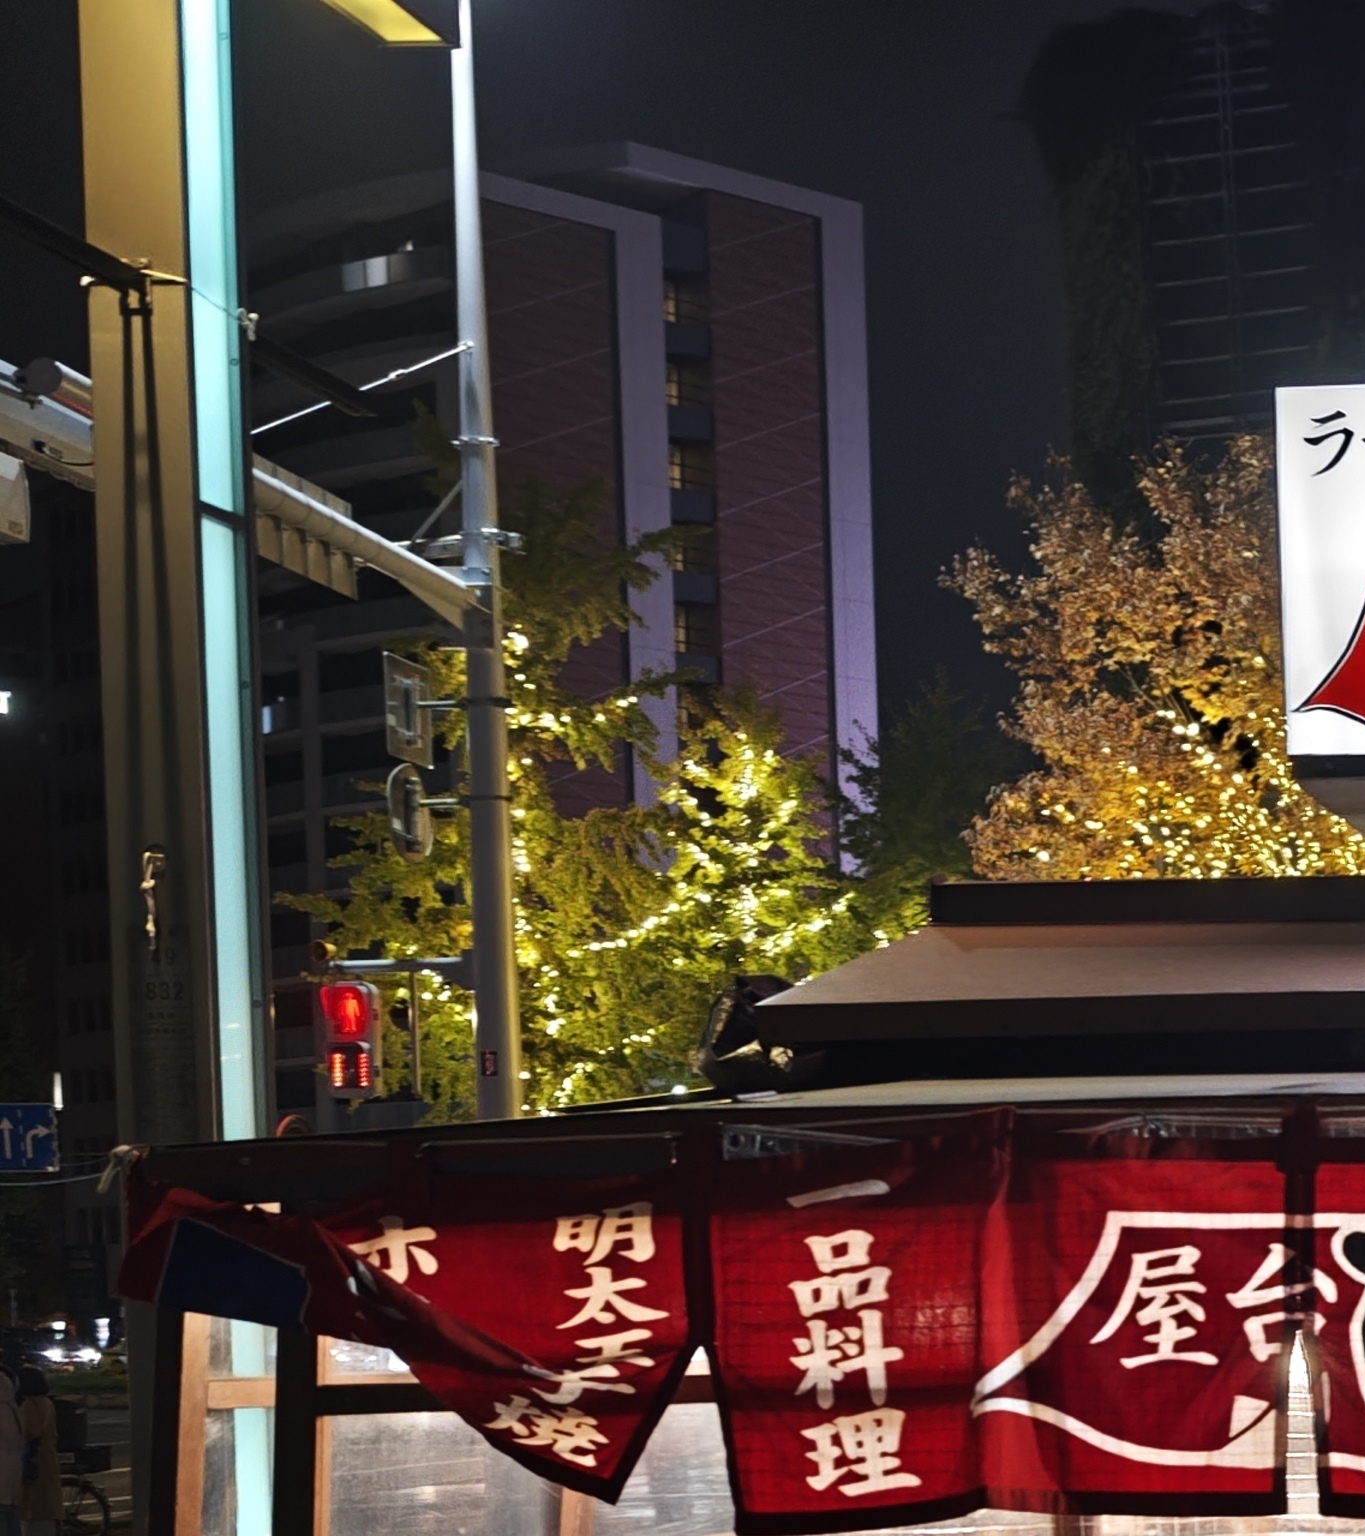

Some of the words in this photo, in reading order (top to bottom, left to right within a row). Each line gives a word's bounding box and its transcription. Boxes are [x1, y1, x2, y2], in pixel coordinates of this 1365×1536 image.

[787, 1179, 924, 1497] 一品料理
[1090, 1242, 1338, 1369] 屋台
